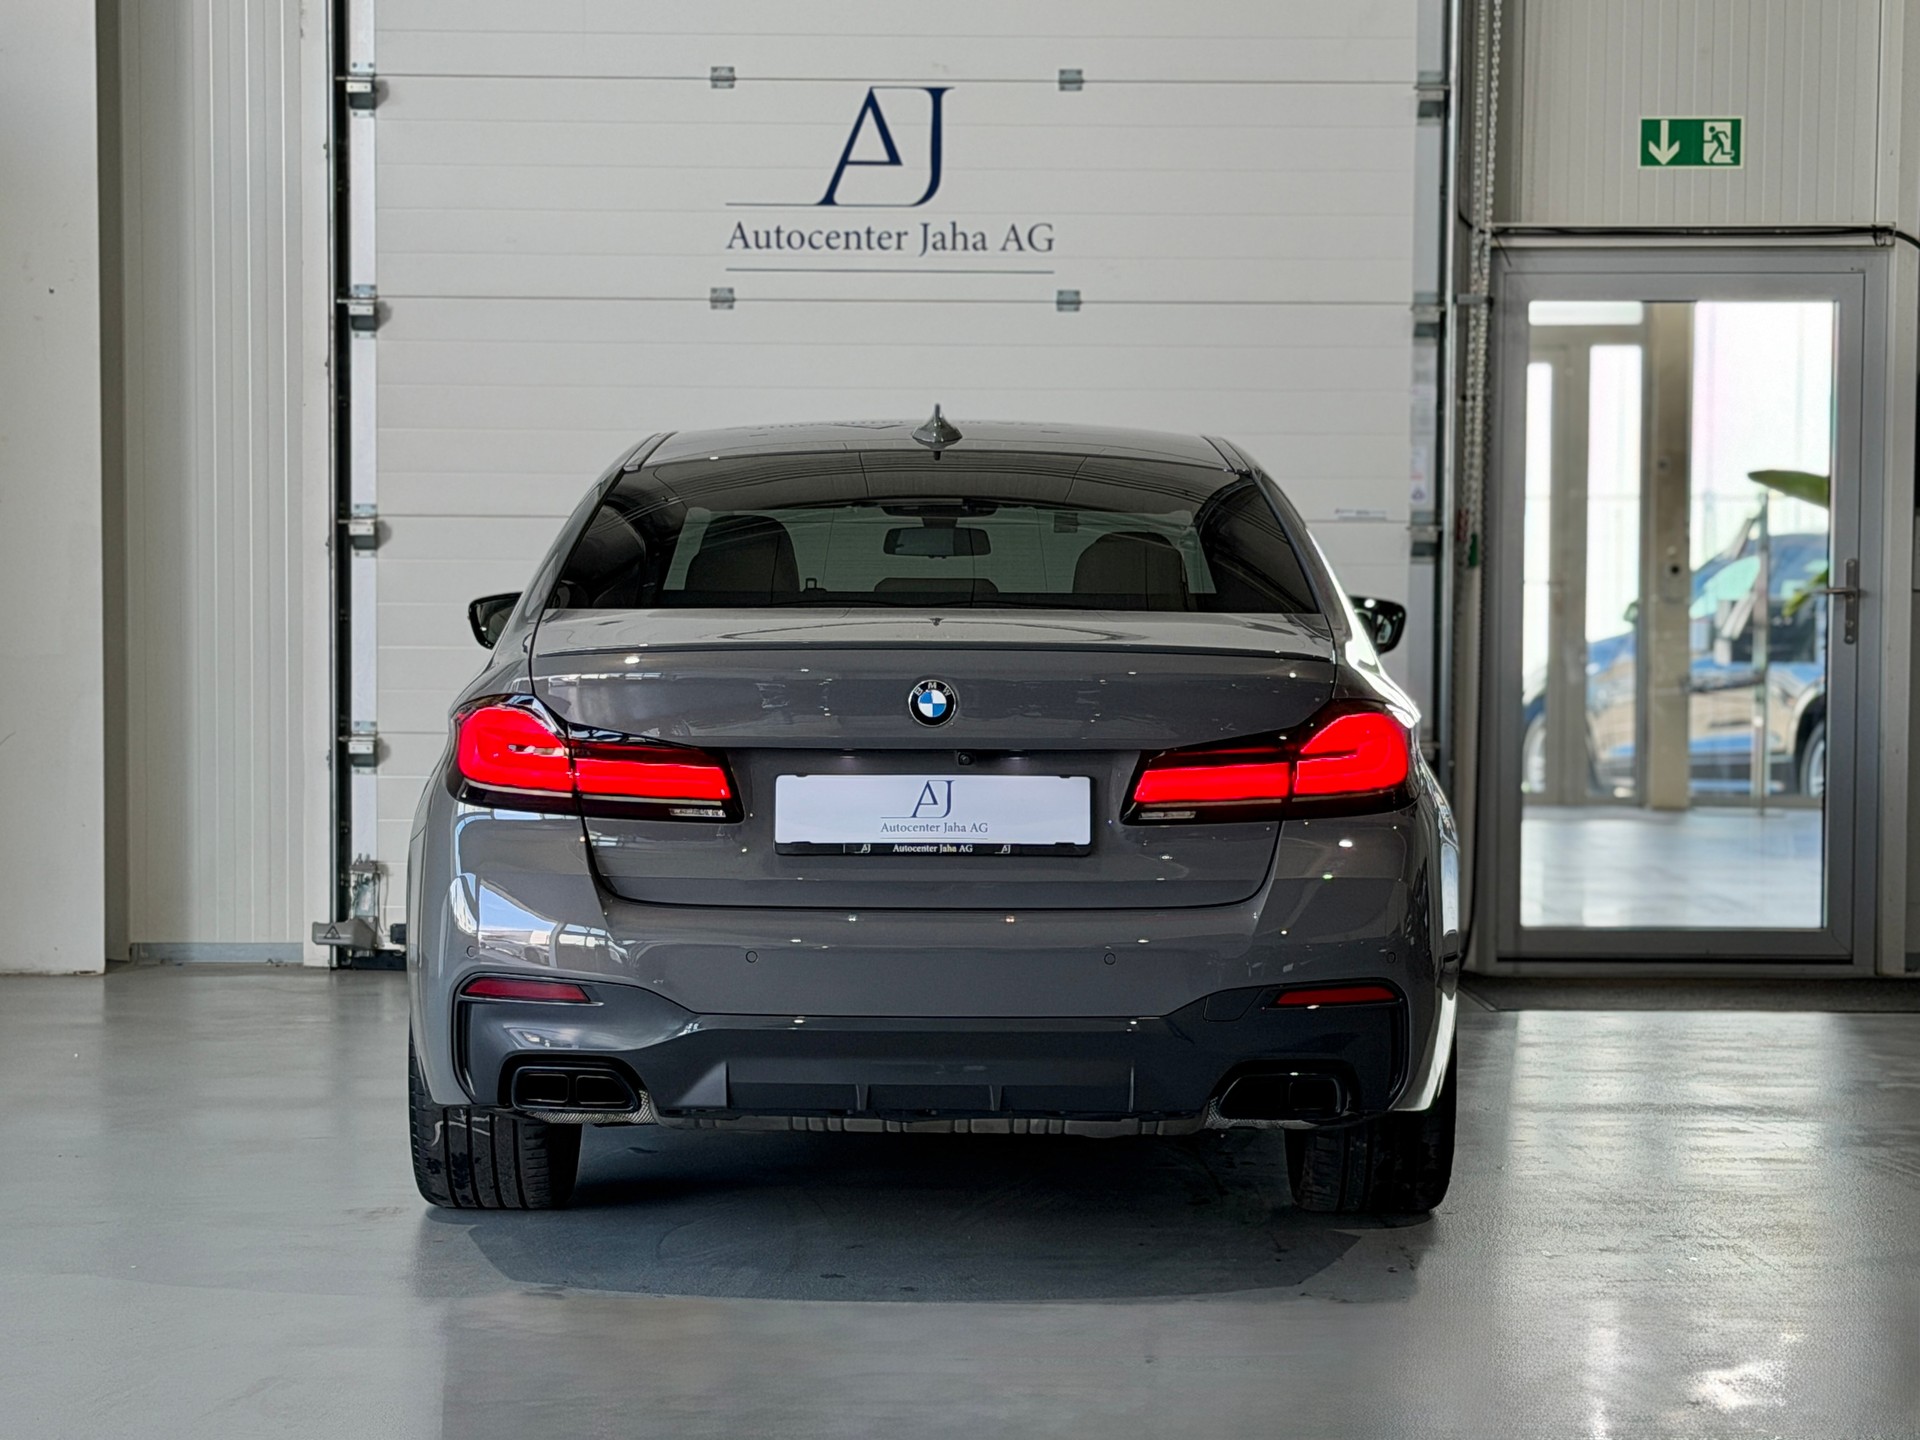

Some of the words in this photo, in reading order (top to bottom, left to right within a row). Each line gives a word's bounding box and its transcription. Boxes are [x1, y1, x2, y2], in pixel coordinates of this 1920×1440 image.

[817, 85, 954, 207] AJ
[726, 221, 908, 250] Autocenter
[918, 221, 988, 257] Jaha
[999, 223, 1055, 252] AG
[913, 681, 952, 697] BMW
[911, 780, 955, 818] AJ
[880, 822, 941, 833] Autocenter
[943, 822, 967, 834] Jaha
[970, 822, 988, 833] AG
[892, 844, 939, 853] Autocenter
[939, 844, 957, 853] Jaha
[958, 844, 973, 853] AG
